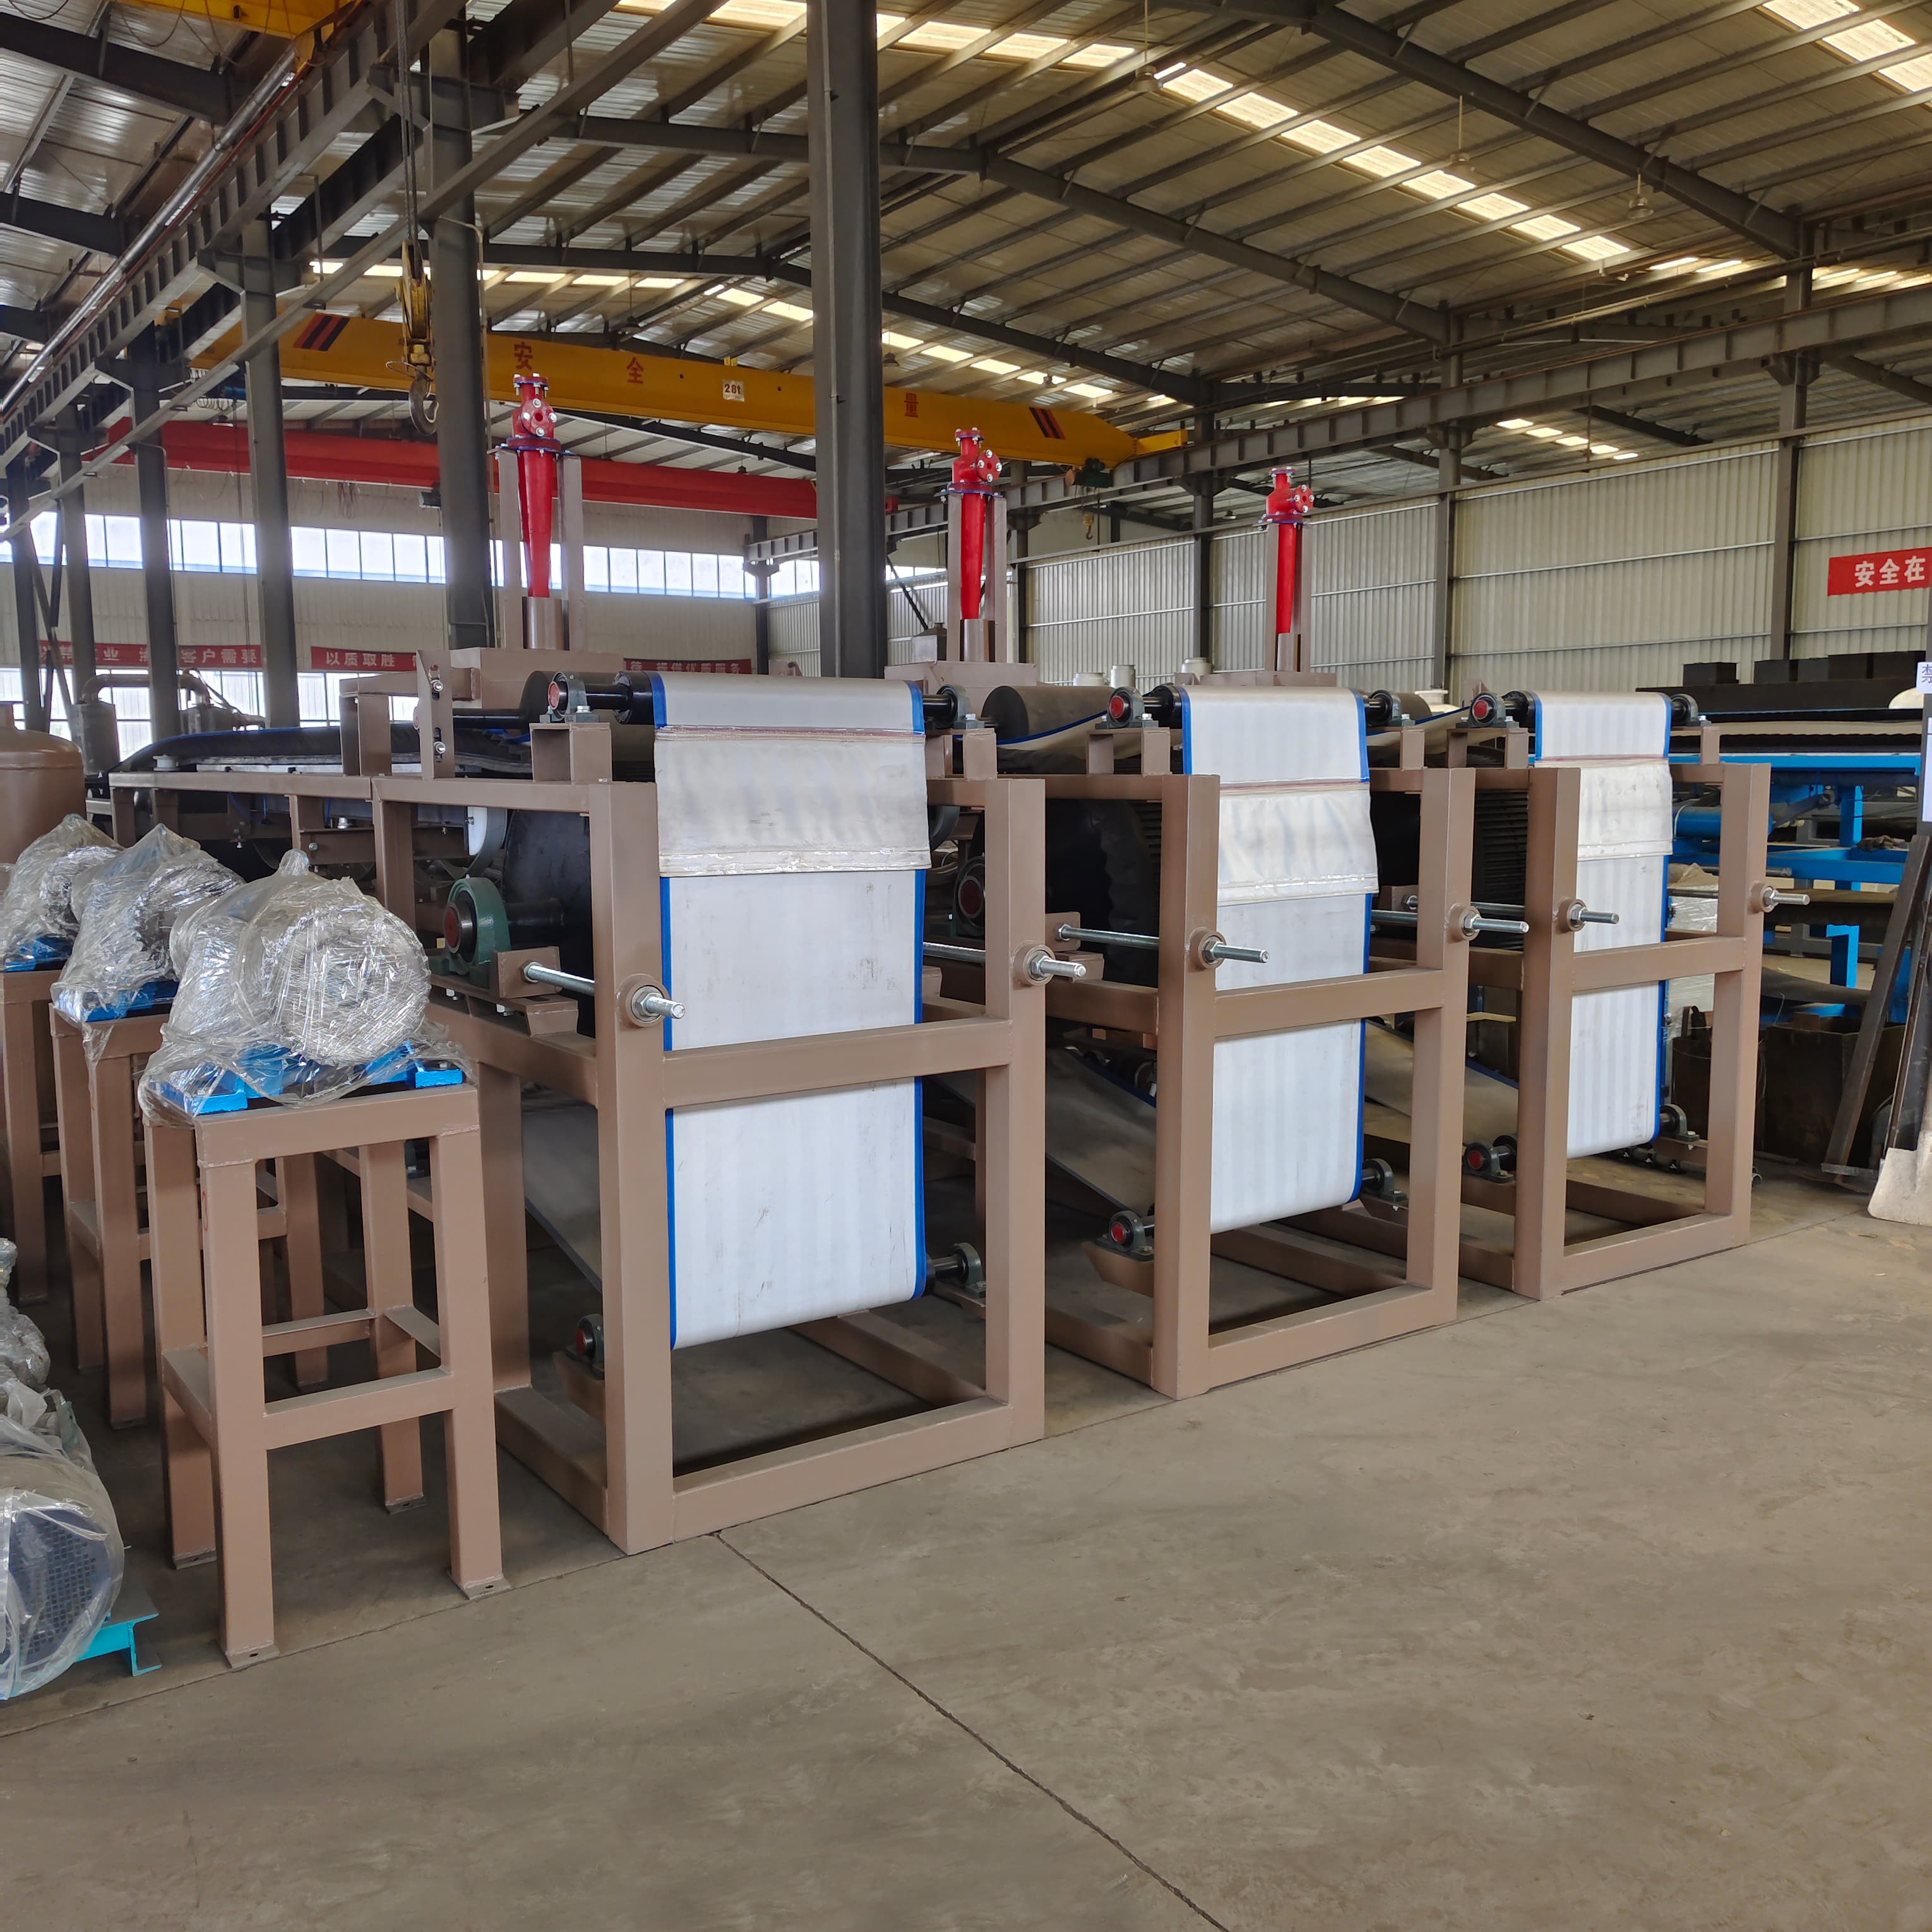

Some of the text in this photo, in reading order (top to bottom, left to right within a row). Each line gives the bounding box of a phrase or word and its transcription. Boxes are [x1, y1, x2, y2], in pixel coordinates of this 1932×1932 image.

[514, 342, 644, 384] 安 全
[724, 383, 741, 394] 28t
[904, 392, 919, 418] 量
[1854, 556, 1926, 587] 安全在
